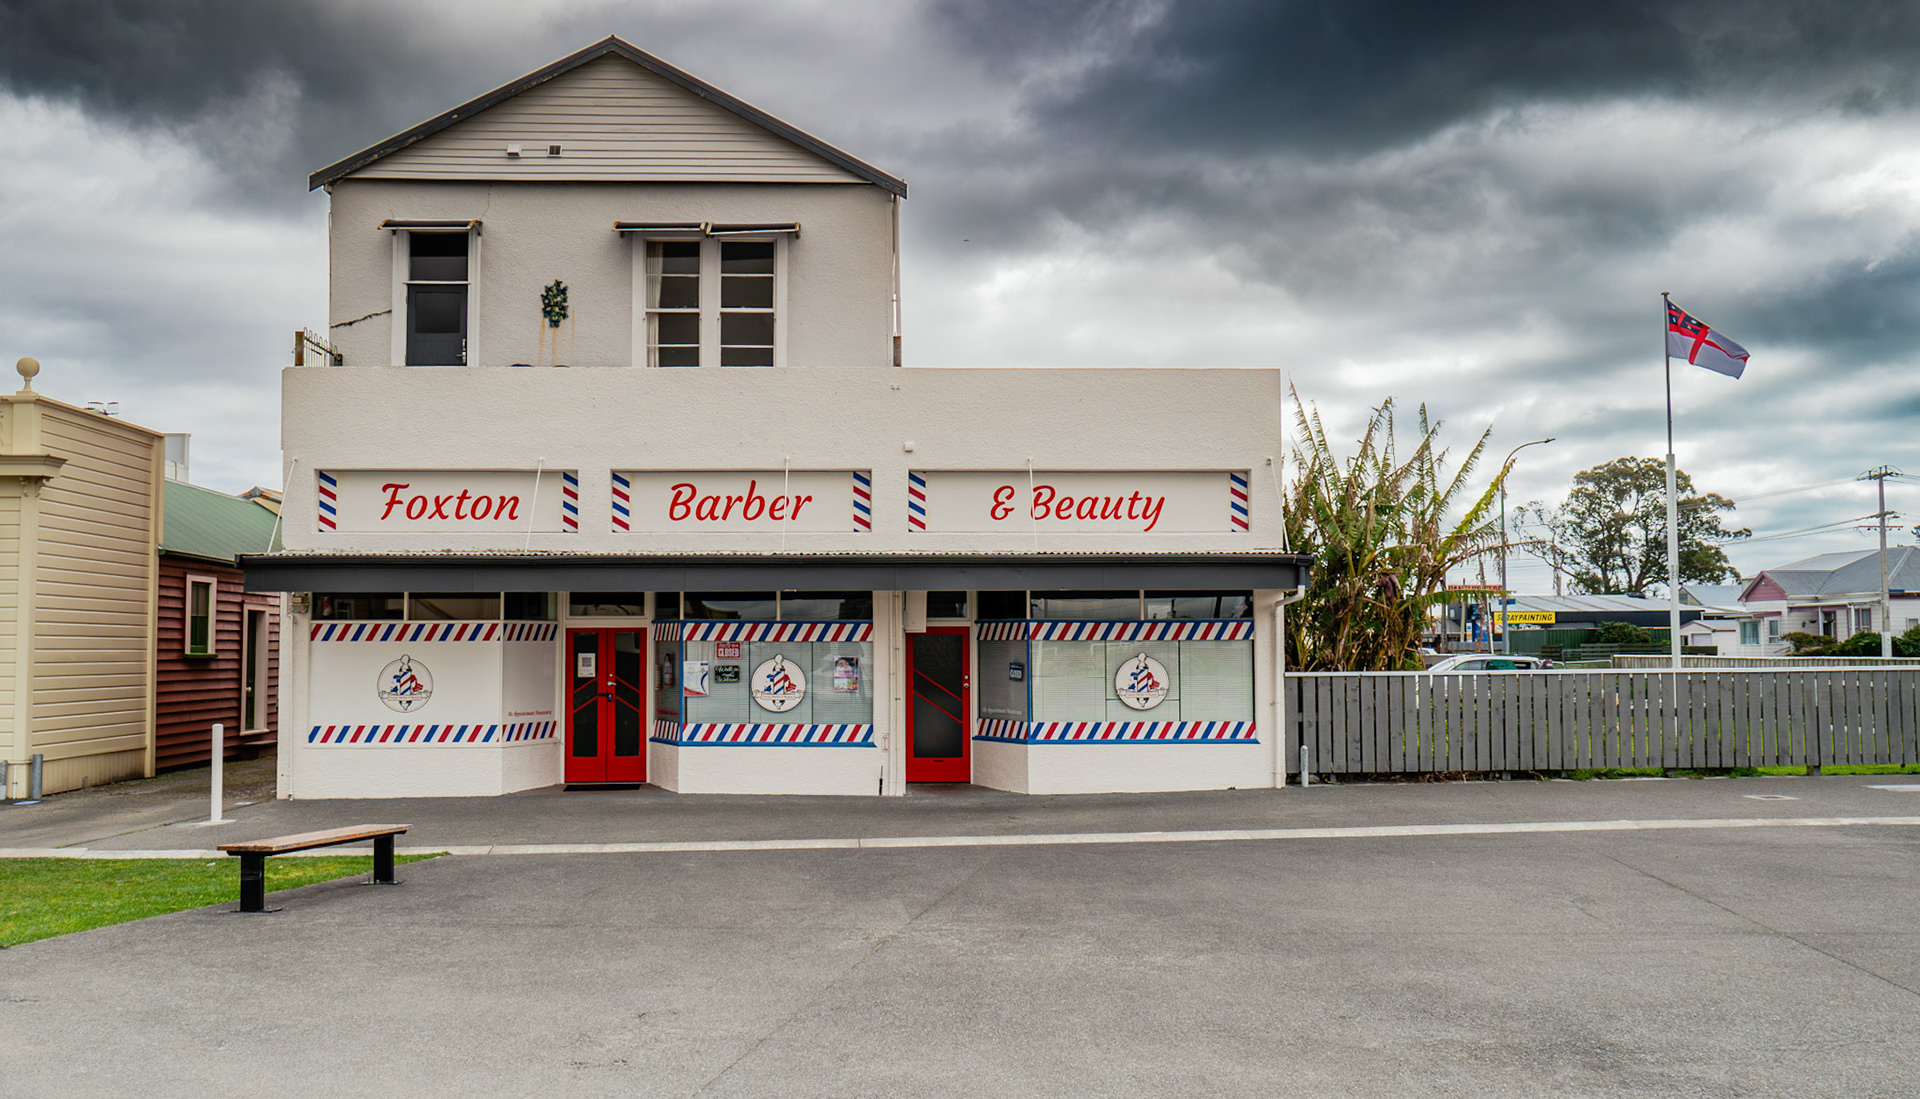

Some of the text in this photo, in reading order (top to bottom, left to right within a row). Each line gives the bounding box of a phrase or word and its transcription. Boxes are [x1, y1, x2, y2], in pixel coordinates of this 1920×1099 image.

[381, 483, 520, 520] Foxton
[669, 480, 813, 521] Barber
[990, 485, 1166, 532] & Beauty
[718, 648, 739, 657] CLOSED
